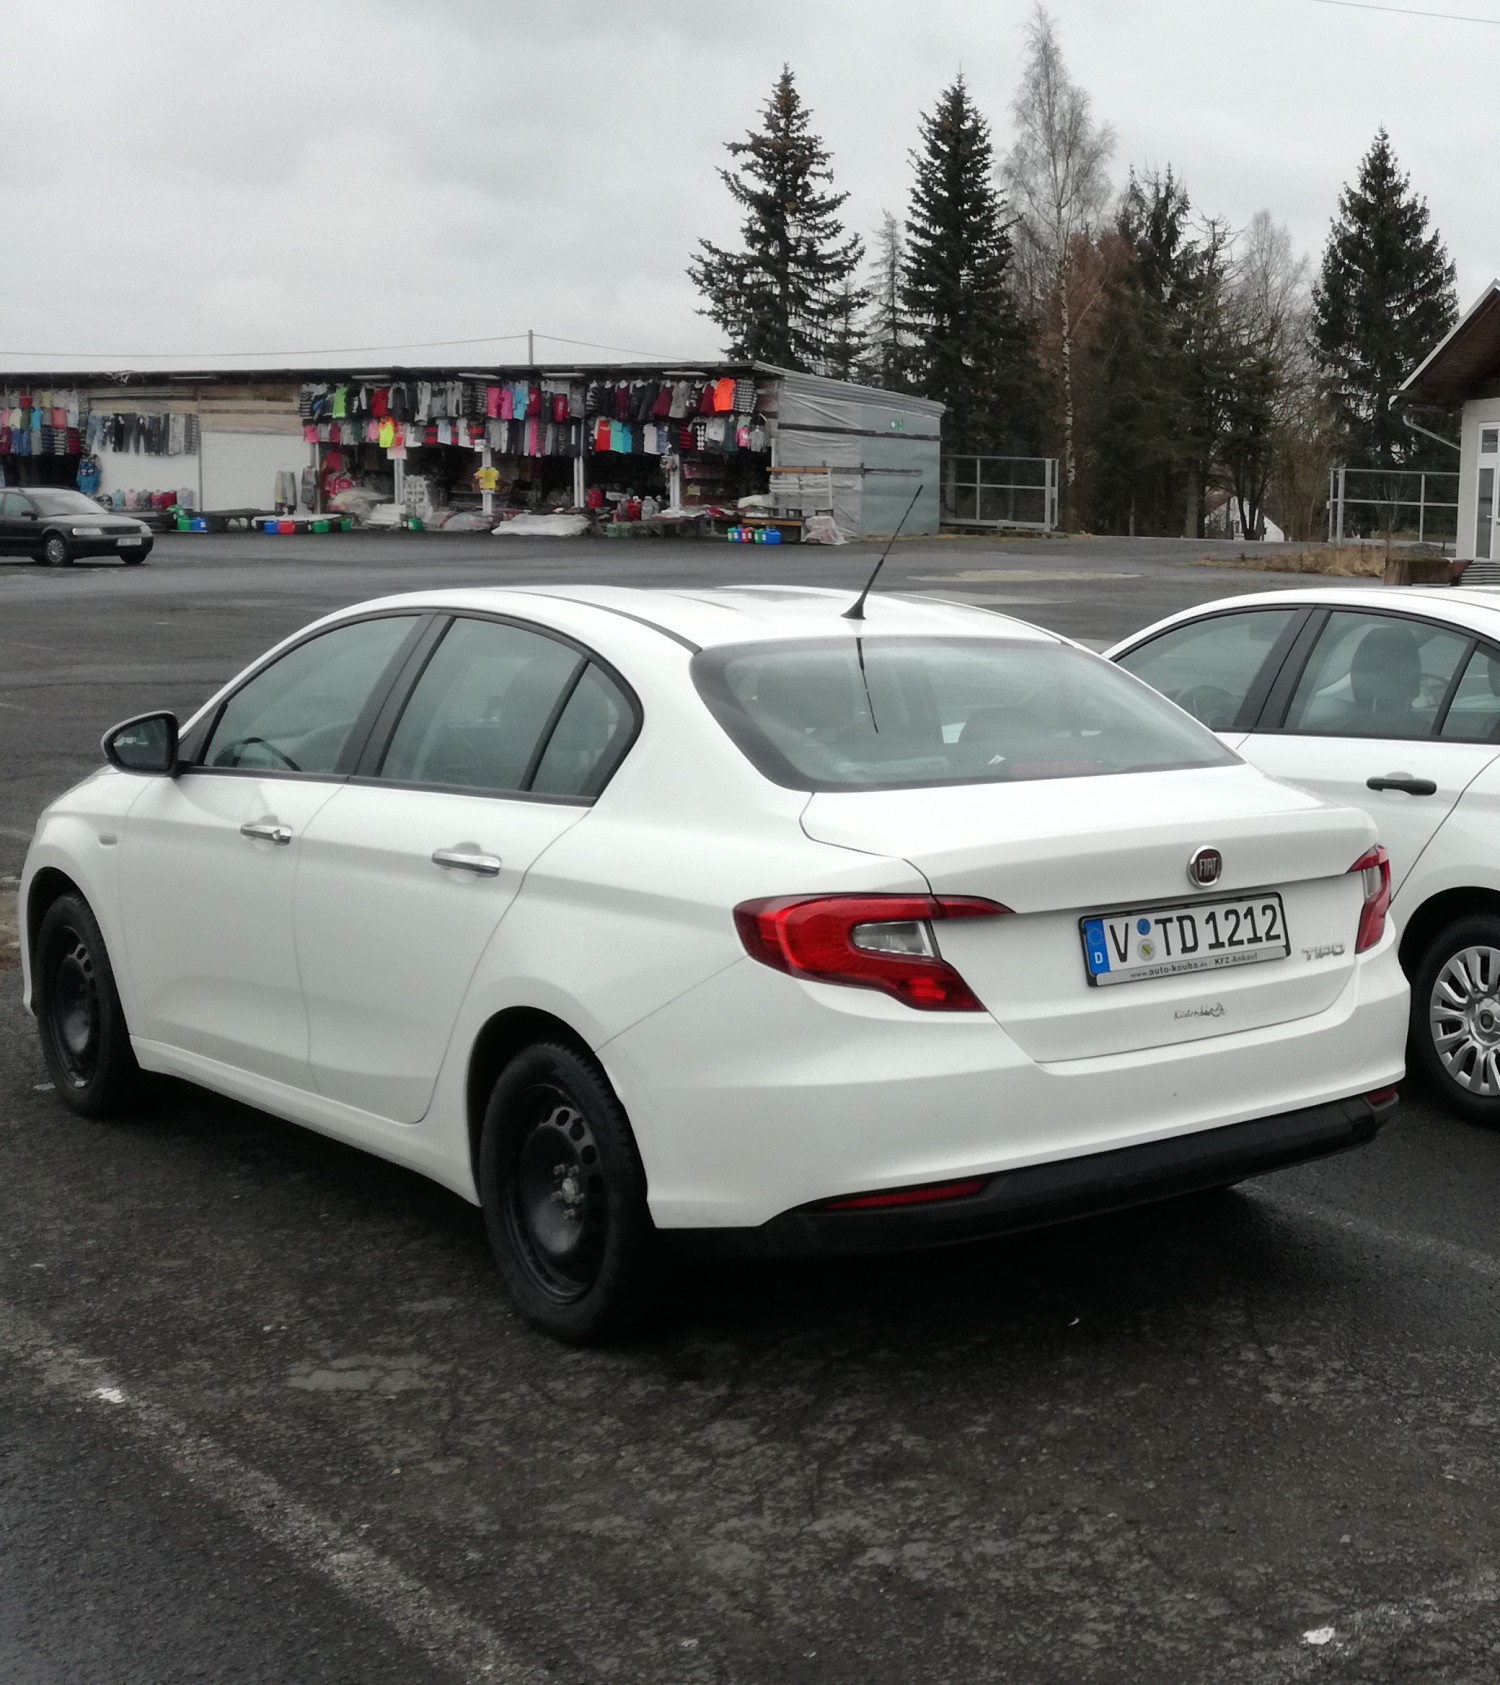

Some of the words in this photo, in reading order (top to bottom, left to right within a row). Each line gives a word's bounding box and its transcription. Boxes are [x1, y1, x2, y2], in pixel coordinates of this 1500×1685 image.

[1198, 856, 1218, 878] FIAT
[1109, 922, 1130, 964] V
[1154, 914, 1199, 956] TD
[1204, 904, 1281, 950] 1212
[1094, 951, 1104, 965] D
